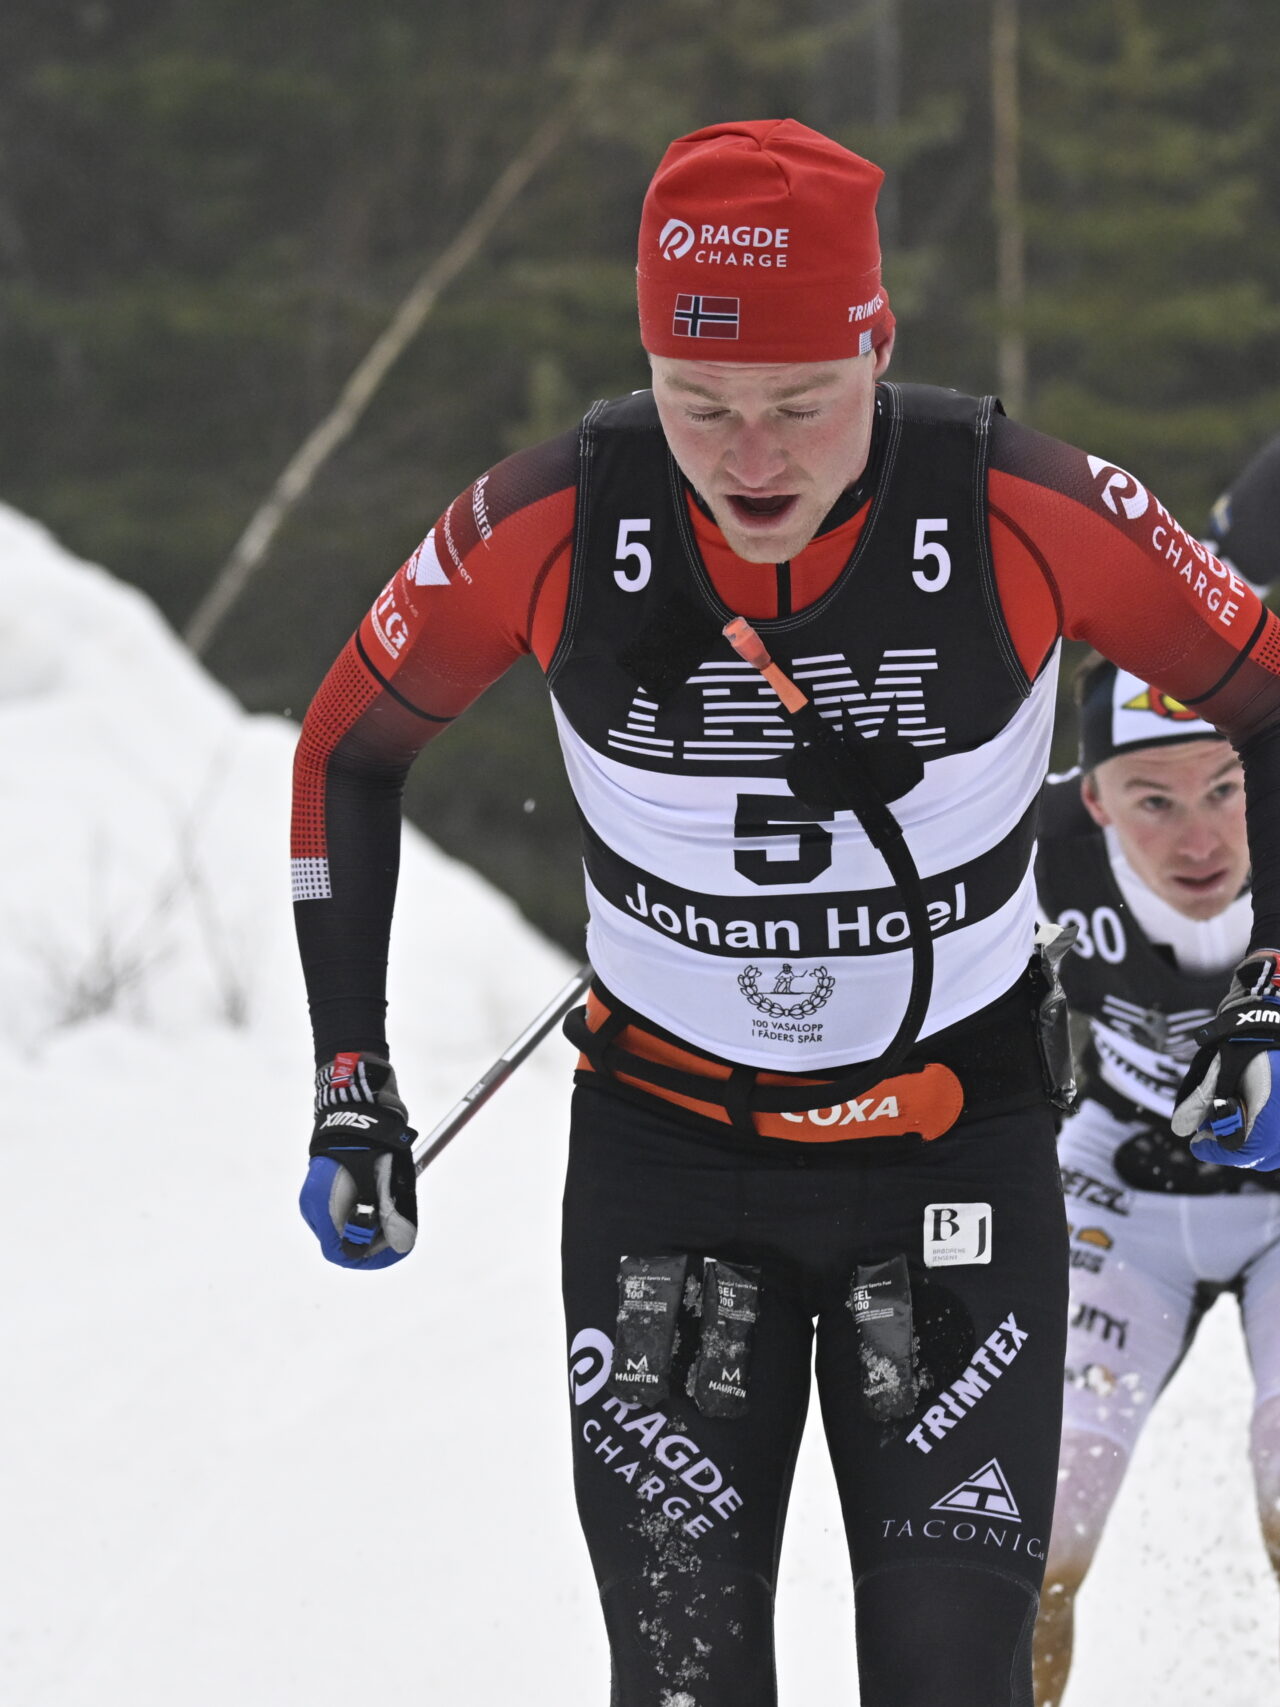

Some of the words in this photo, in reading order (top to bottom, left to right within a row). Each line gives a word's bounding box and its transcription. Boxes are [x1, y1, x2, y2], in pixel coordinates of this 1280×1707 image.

[701, 225, 789, 248] RAGDE
[695, 250, 787, 268] CHARGE
[473, 475, 493, 541] Aspira
[613, 518, 653, 593] 5
[911, 518, 952, 593] 5
[1152, 526, 1239, 626] CHARGE
[734, 793, 835, 887] 5
[625, 883, 800, 951] Johan
[826, 882, 966, 950] Hoel
[752, 1019, 768, 1028] 100
[771, 1021, 823, 1032] VASALOPP
[758, 1029, 794, 1043] FÄDERS
[797, 1033, 822, 1043] SPÅR
[320, 1111, 378, 1130] SWIX
[718, 1286, 736, 1298] GEL
[854, 1290, 872, 1302] GEL
[615, 1373, 659, 1384] MAURTEN
[708, 1381, 747, 1398] MAURTEN
[906, 1312, 1029, 1454] TRIMTEX
[602, 1396, 744, 1520] RAGDE
[583, 1419, 715, 1539] CHARGE
[882, 1519, 1041, 1557] TACONIC
